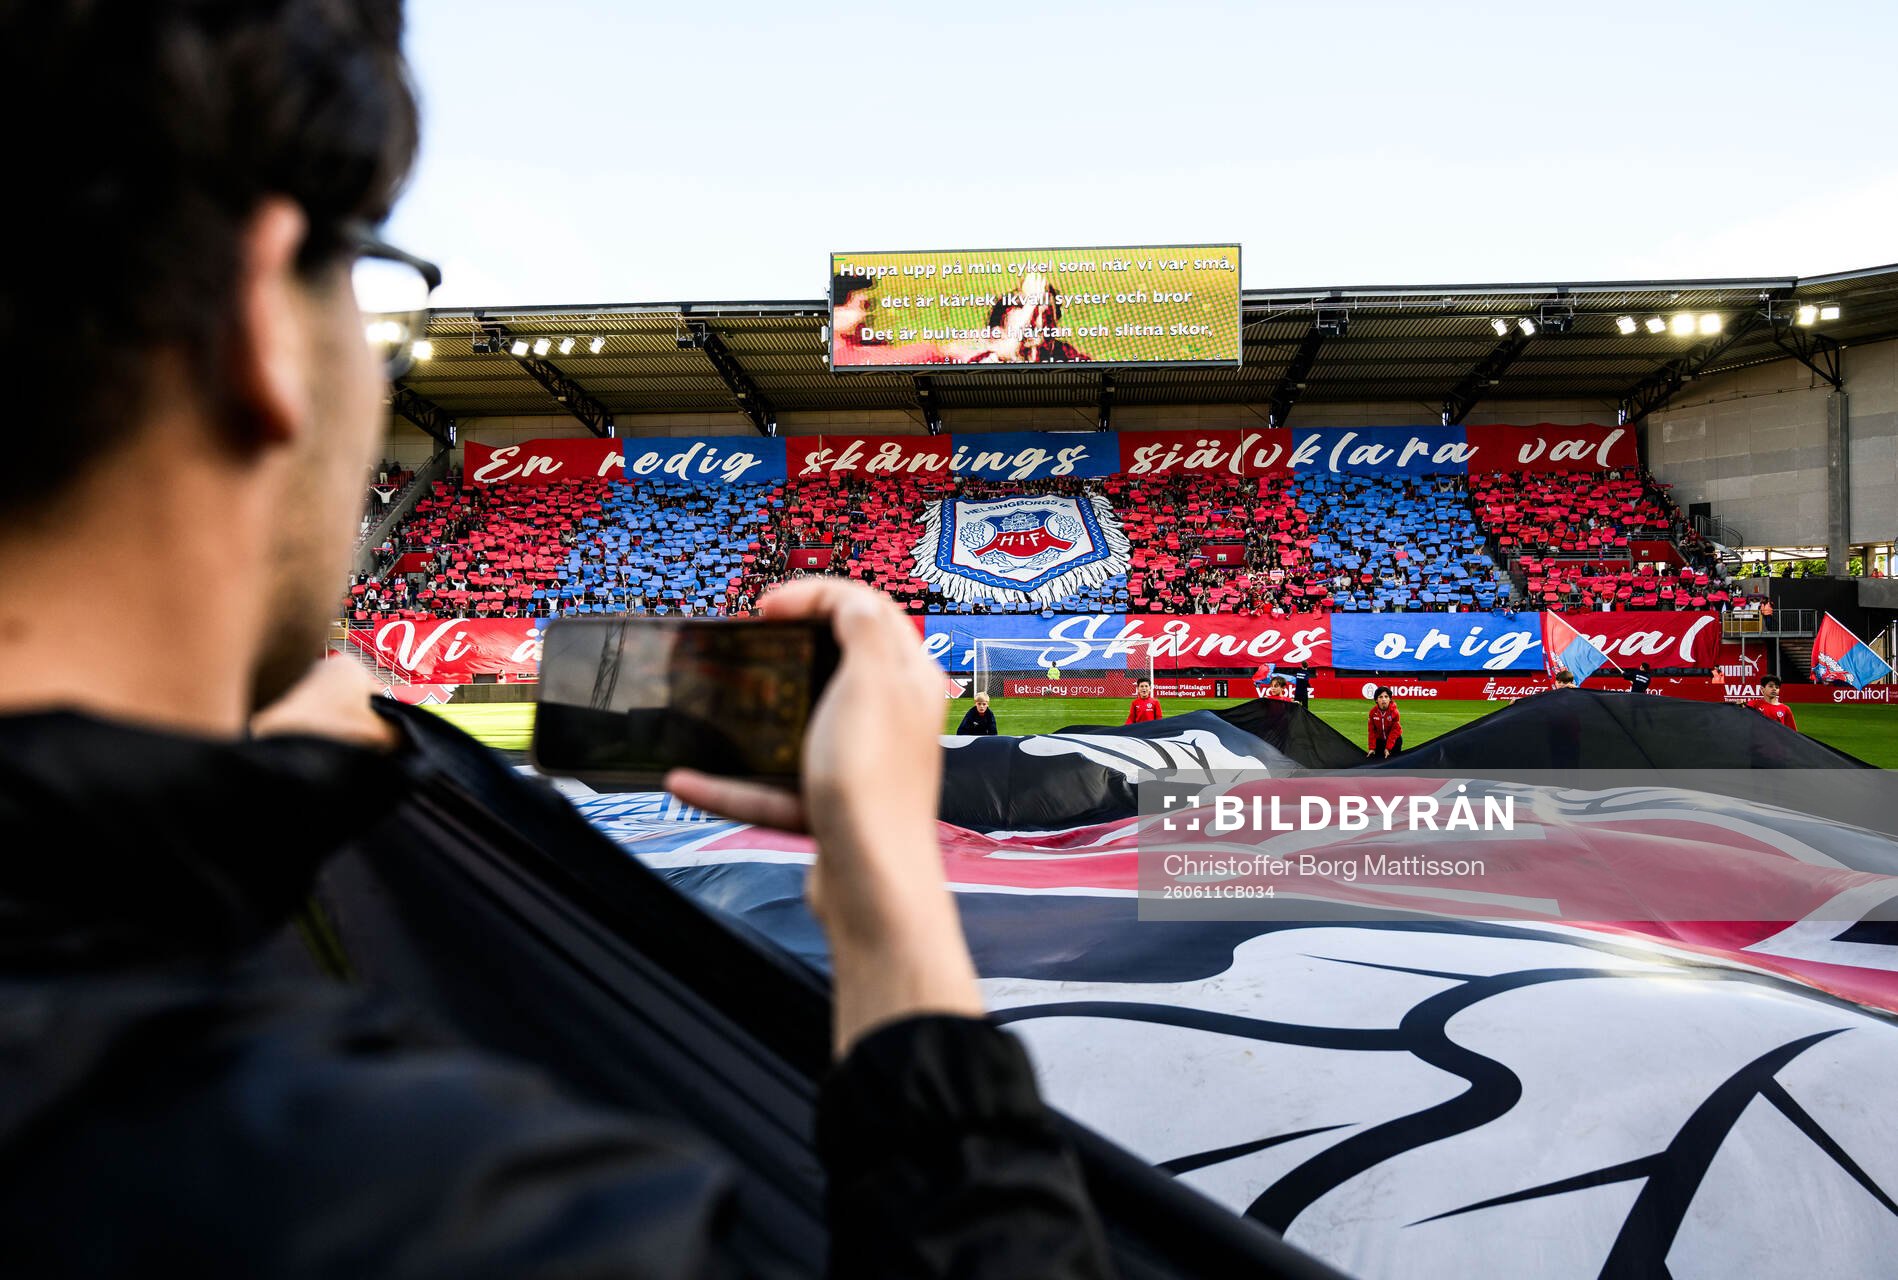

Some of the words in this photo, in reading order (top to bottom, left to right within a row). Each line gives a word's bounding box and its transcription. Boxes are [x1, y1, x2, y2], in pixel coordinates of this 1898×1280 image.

[840, 264, 898, 280] Hoppa
[903, 264, 937, 280] upp
[942, 260, 963, 277] på
[968, 262, 1002, 274] min
[1008, 259, 1053, 277] cykel
[1059, 261, 1096, 272] som
[1102, 257, 1132, 272] när
[1137, 257, 1153, 271] vi
[1158, 259, 1188, 271] var
[1193, 255, 1236, 272] små,
[881, 295, 911, 308] det
[916, 295, 935, 308] är
[939, 293, 997, 308] kärlek
[1002, 292, 1050, 306] ikväll
[1055, 291, 1111, 309] syster
[1116, 290, 1147, 305] och
[1153, 290, 1193, 304] bror
[861, 327, 894, 341] Det
[900, 326, 918, 340] är
[923, 326, 1002, 340] bultande
[1007, 324, 1072, 341] hjärtan
[1078, 323, 1109, 338] och
[1115, 323, 1164, 337] slitna
[1170, 322, 1213, 338] skor,
[473, 445, 563, 484] En
[597, 442, 762, 483] redig
[799, 440, 1090, 481] skånings
[1517, 429, 1625, 468] val
[964, 499, 1057, 515] HELSINGBORGS
[375, 617, 472, 671] Vi
[511, 628, 544, 663] ä
[1037, 614, 1332, 668] Skånes
[1374, 615, 1716, 670] orignal
[1014, 684, 1068, 696] letusplay
[1070, 685, 1105, 696] group
[1380, 685, 1438, 697] llOffice
[1495, 686, 1549, 695] BOLAGET
[1833, 687, 1886, 703] granitor
